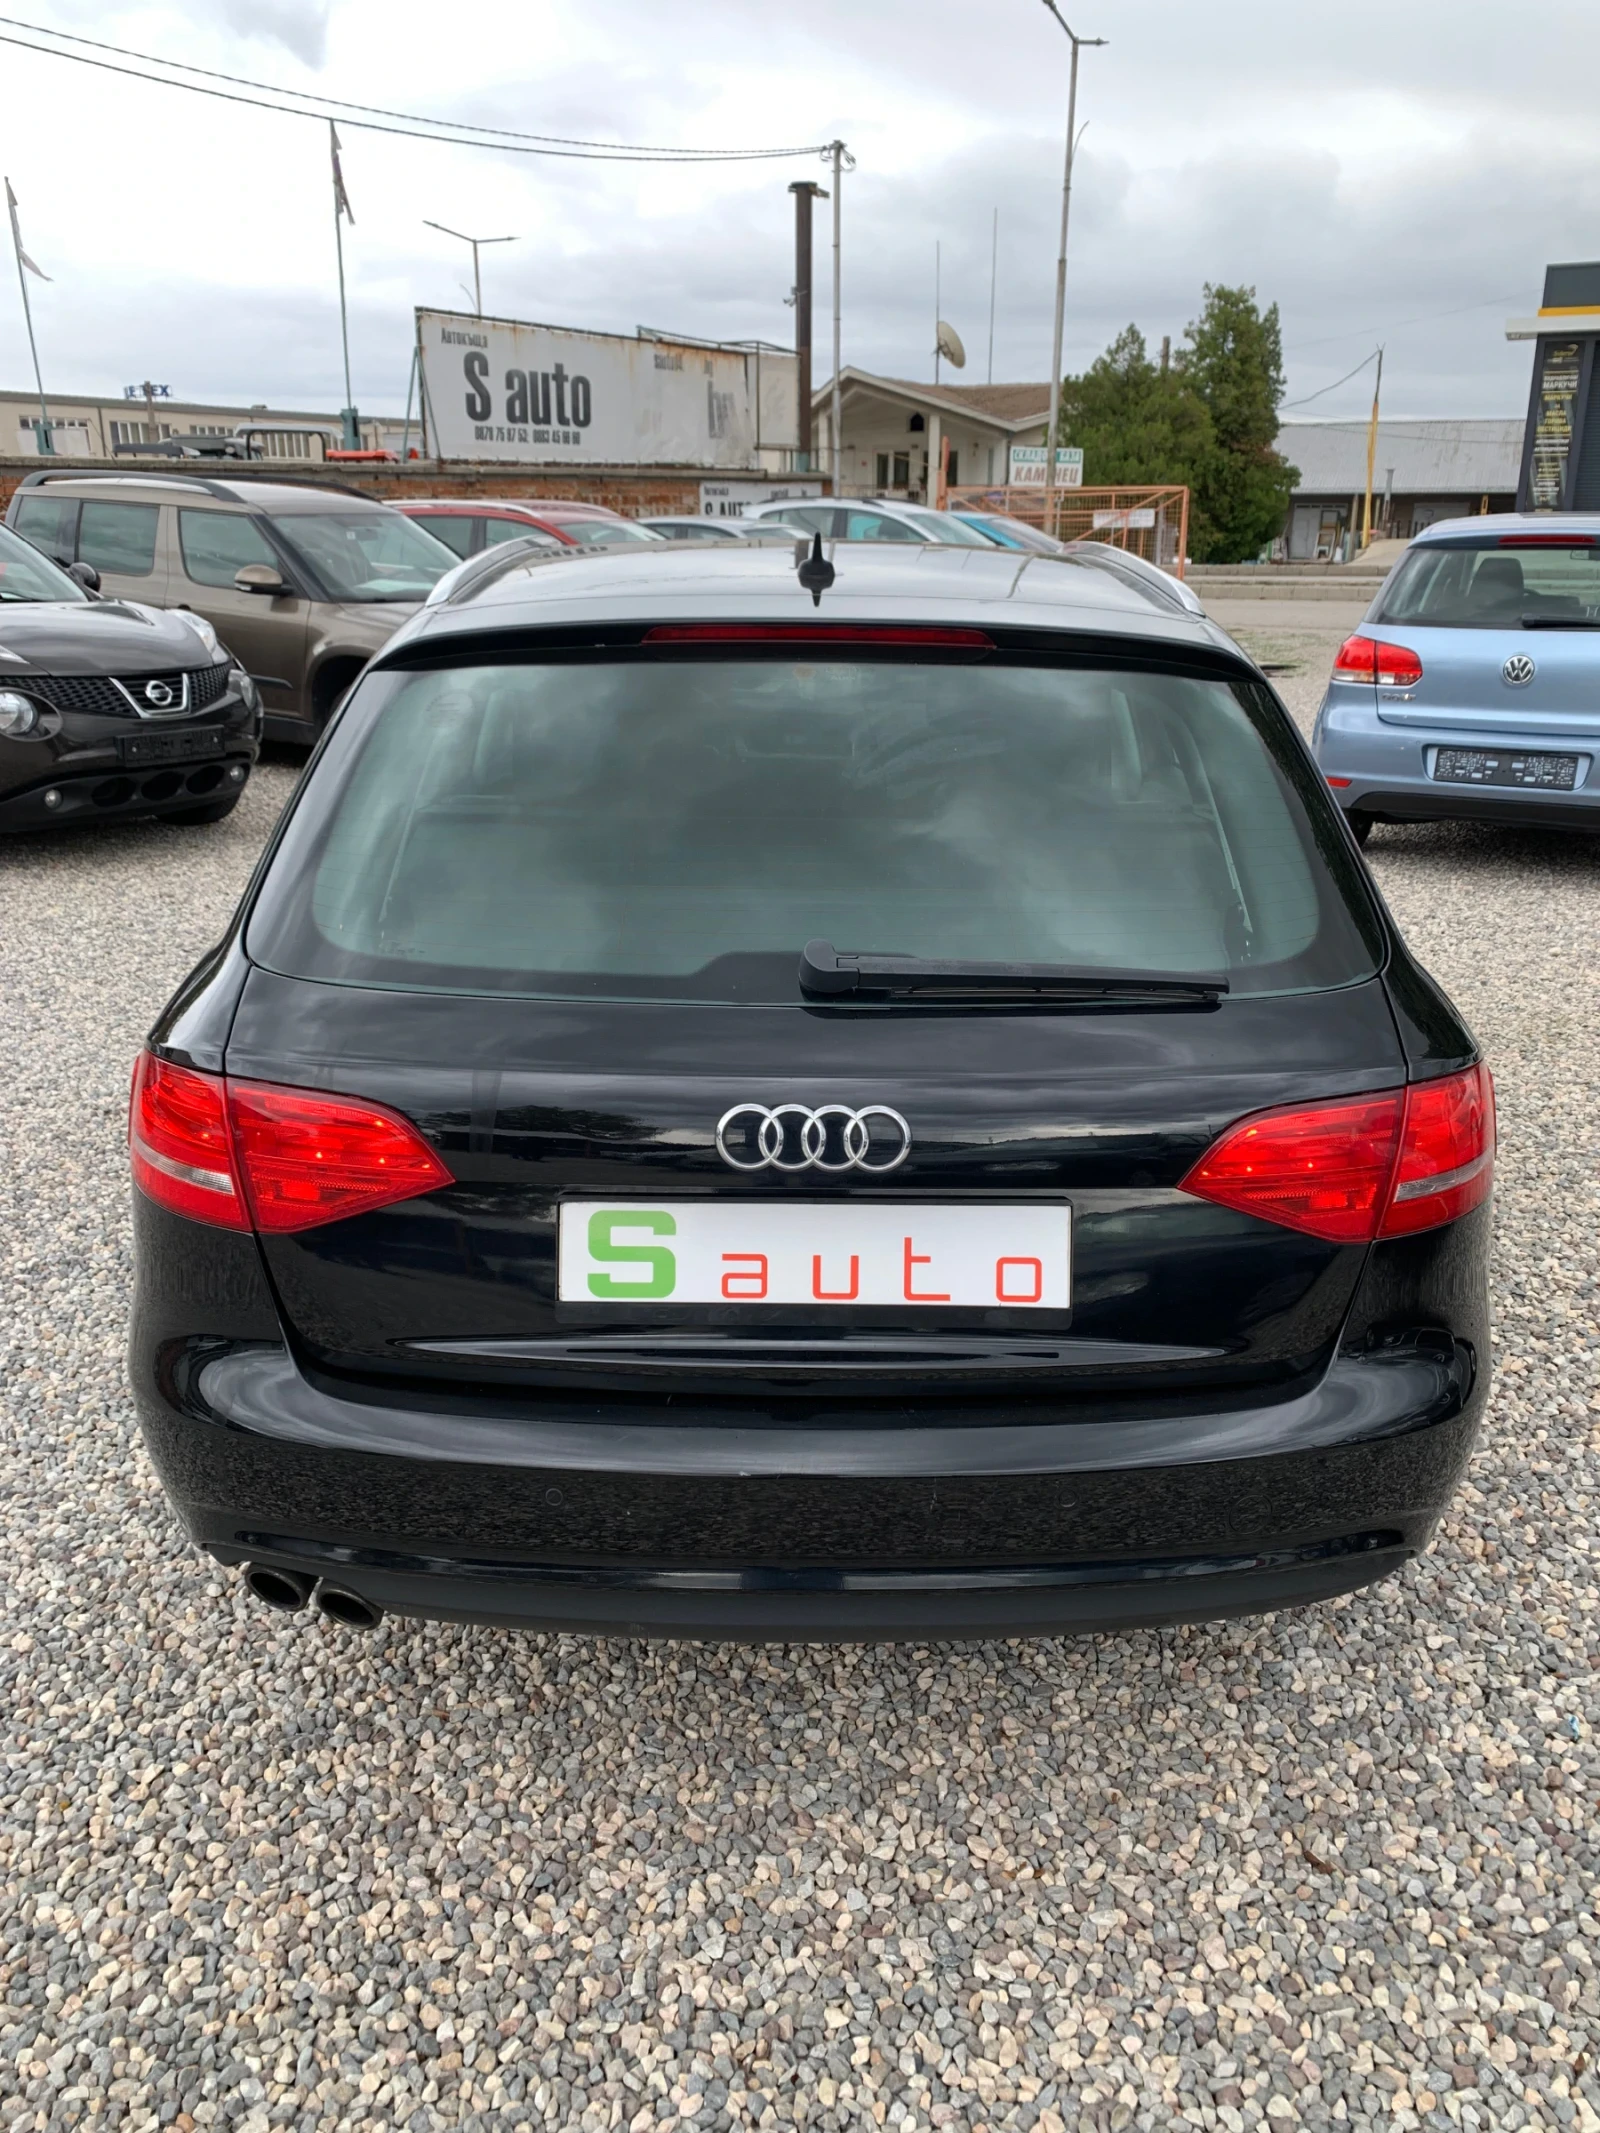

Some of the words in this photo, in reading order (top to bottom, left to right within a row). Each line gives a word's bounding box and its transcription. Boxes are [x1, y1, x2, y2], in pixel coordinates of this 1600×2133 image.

[464, 351, 492, 422] S
[505, 362, 591, 428] auto
[1543, 380, 1578, 389] МАРКУЧИ
[1015, 466, 1079, 484] КАМНЕЦ
[587, 1210, 677, 1298] S
[721, 1237, 1042, 1302] auto
